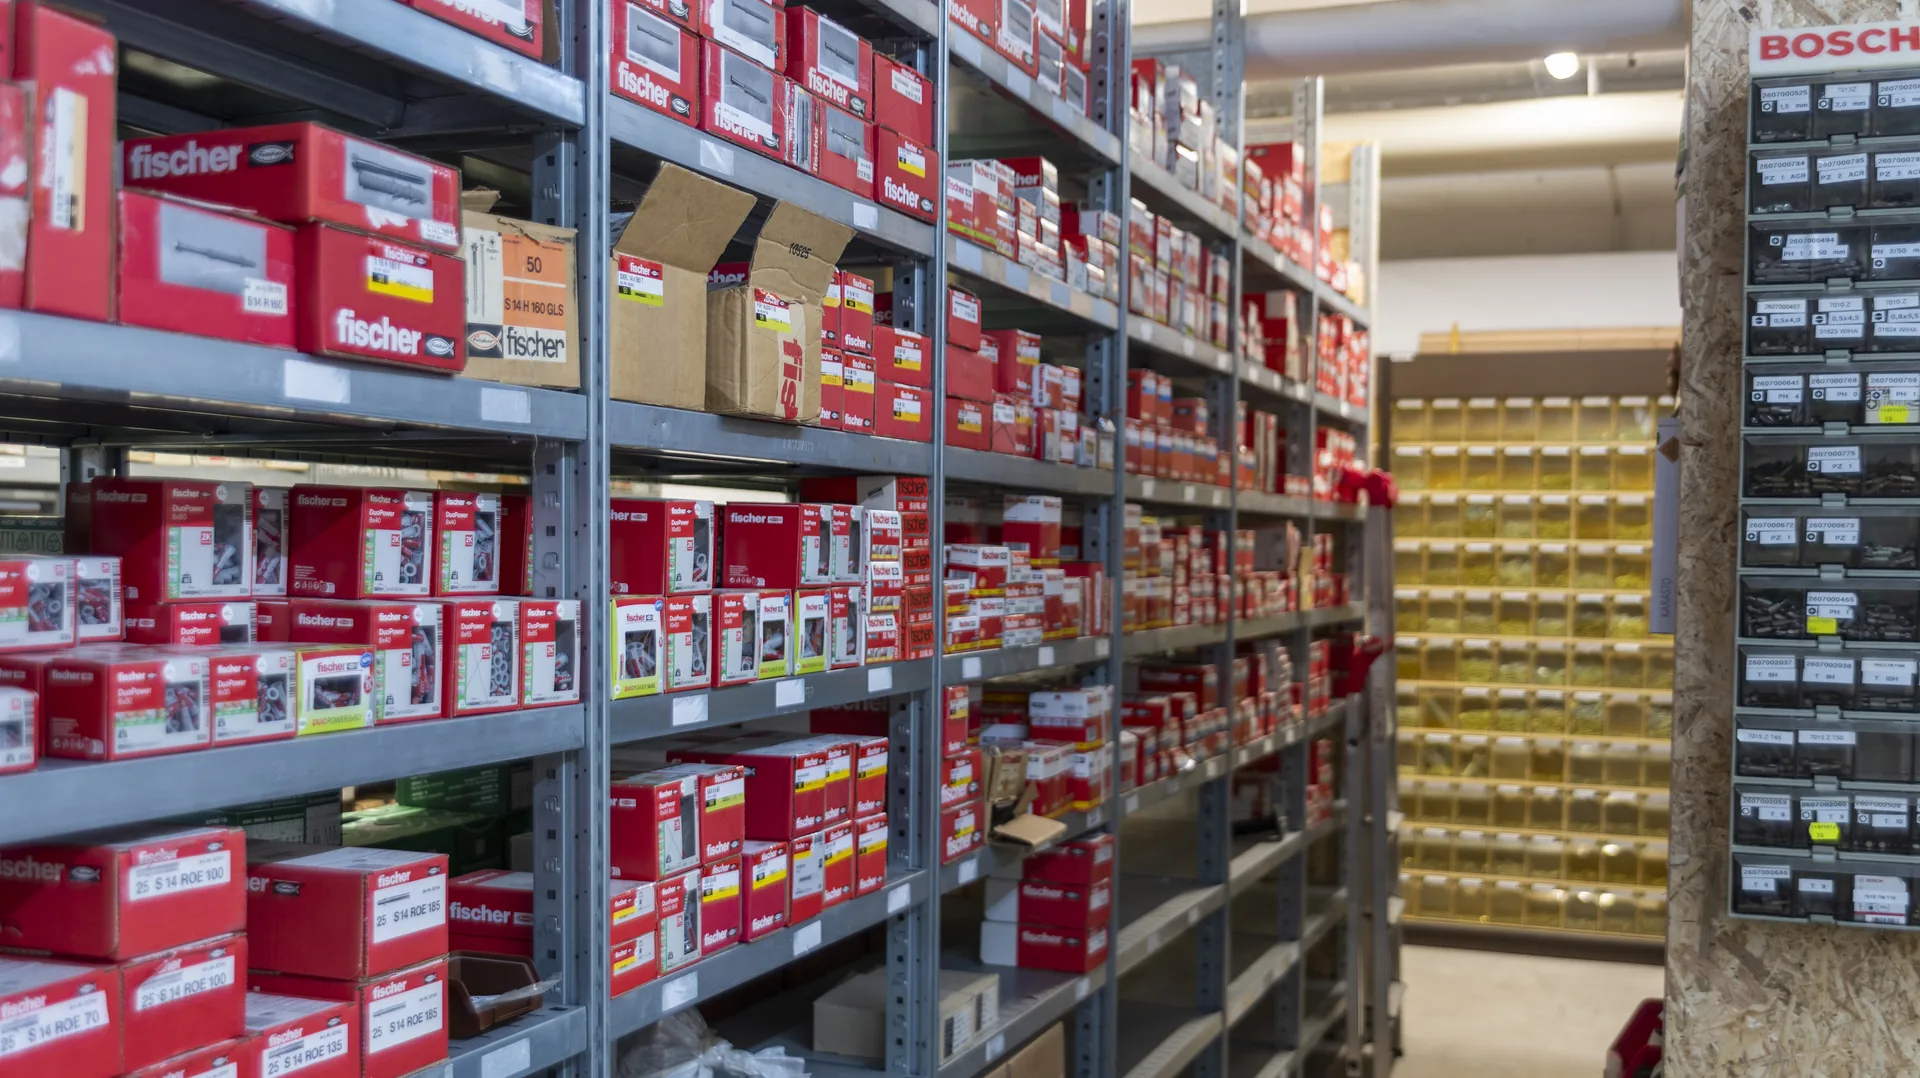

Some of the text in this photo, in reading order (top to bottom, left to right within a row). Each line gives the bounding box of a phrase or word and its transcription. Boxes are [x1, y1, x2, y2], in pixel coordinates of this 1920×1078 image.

[1760, 26, 1920, 60] BOSCH
[618, 62, 669, 108] fischer
[808, 67, 848, 105] fischer
[1762, 90, 1808, 98] 2607000525
[130, 139, 243, 180] fischer
[1759, 160, 1805, 169] 2607000784
[1818, 158, 1865, 168] 2607000785
[884, 176, 919, 209] fischer
[384, 246, 415, 264] fischer
[789, 243, 812, 260] 10525
[526, 256, 542, 273] 50
[630, 262, 651, 276] fischer
[853, 278, 867, 289] fischer
[504, 297, 564, 317] S 14 H 160 GLS
[337, 308, 421, 355] fischer
[507, 326, 564, 358] fischer
[845, 334, 867, 348] fischer
[901, 338, 915, 349] fischer
[852, 360, 866, 370] fischer
[900, 390, 914, 400] fischer
[845, 414, 864, 427] fischer
[172, 489, 200, 499] fischer
[370, 494, 391, 504] fischer
[298, 494, 331, 506] fischer
[446, 497, 465, 507] fischer
[172, 504, 204, 513] DuoPower
[369, 509, 395, 518] DuoPower
[671, 507, 686, 515] fischer
[445, 511, 468, 519] DuoPower
[731, 512, 766, 524] fischer
[873, 514, 890, 525] fischer
[903, 554, 930, 568] fischer
[873, 565, 891, 576] fischer
[764, 605, 777, 613] fischer
[805, 603, 819, 611] fischer
[180, 611, 207, 621] fischer
[379, 613, 401, 622] fischer
[461, 609, 481, 617] fischer
[527, 608, 546, 618] fischer
[626, 612, 645, 622] fischer
[670, 614, 687, 622] DuoPower
[298, 613, 336, 627] fischer
[180, 627, 211, 636] DuoPower
[527, 622, 549, 630] DuoPower
[379, 628, 405, 636] DuoPower
[217, 664, 241, 675] fischer
[317, 661, 345, 673] fischer
[117, 671, 146, 683] fischer
[217, 679, 246, 689] DuoPower
[117, 687, 152, 698] DuoPower
[828, 750, 841, 758] fischer
[804, 758, 819, 767] fischer
[715, 771, 733, 784] fischer
[659, 790, 673, 799] fischer
[659, 801, 676, 811] DuoPower
[858, 802, 876, 812] fischer
[796, 817, 814, 829] fischer
[706, 841, 730, 858] fischer
[761, 850, 777, 861] fischer
[712, 864, 730, 875] fischer
[136, 866, 224, 895] 25 S 14 ROE 100
[377, 871, 411, 888] fischer
[860, 877, 876, 889] fischer
[661, 885, 676, 896] fischer
[614, 899, 627, 908] fischer
[661, 897, 678, 906] DuoPower
[377, 899, 441, 928] 25 S 14 ROE 185
[449, 901, 511, 924] fischer
[752, 915, 773, 931] fischer
[704, 929, 727, 947] fischer
[614, 949, 627, 958] fischer
[142, 973, 227, 1008] 25 S 14 ROE 100
[372, 980, 407, 999] fischer
[372, 1007, 438, 1040] 25 S 14 ROE 185
[1, 1009, 100, 1052] 25 S 14 ROE 70
[268, 1027, 303, 1047] fischer
[268, 1039, 342, 1075] 25 S 14 ROE 135
